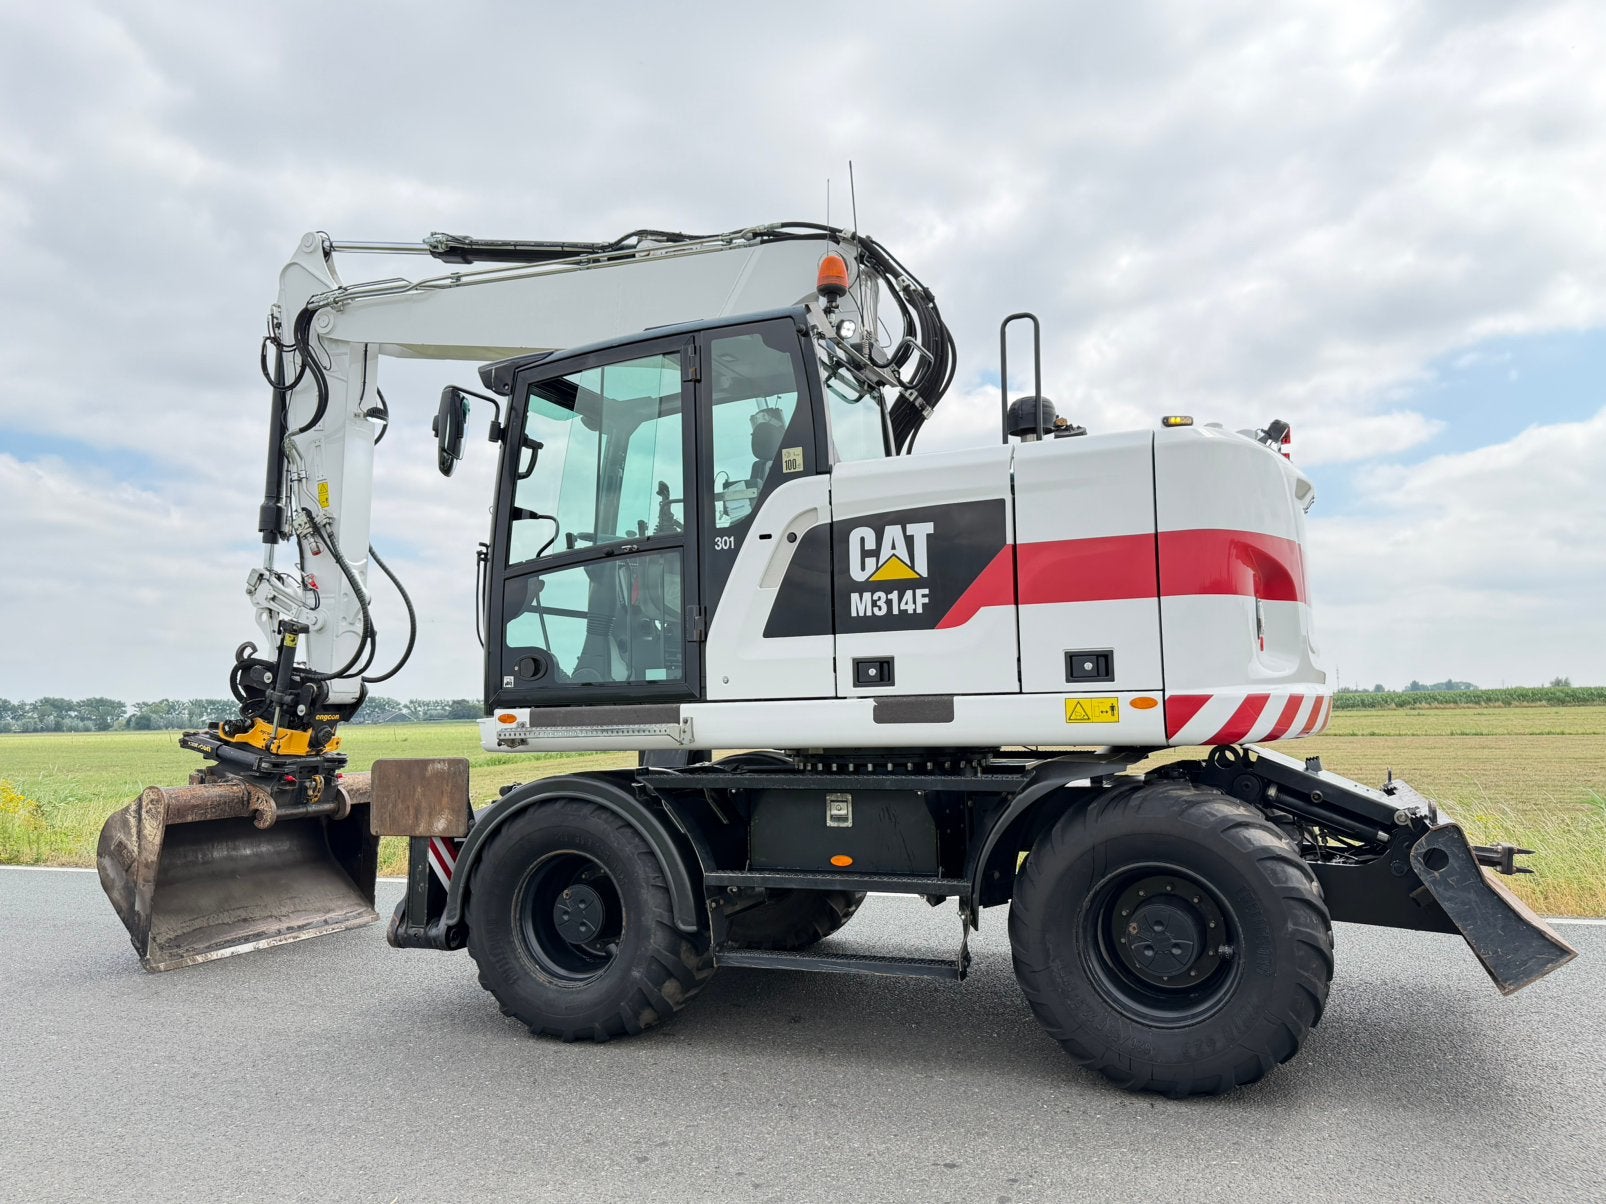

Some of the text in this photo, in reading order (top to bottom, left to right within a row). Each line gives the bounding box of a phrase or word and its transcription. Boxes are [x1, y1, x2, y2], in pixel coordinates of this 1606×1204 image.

[784, 458, 797, 471] 100
[714, 535, 735, 550] 301
[848, 521, 935, 582] CAT
[850, 588, 930, 617] M314F
[315, 714, 340, 722] engcon
